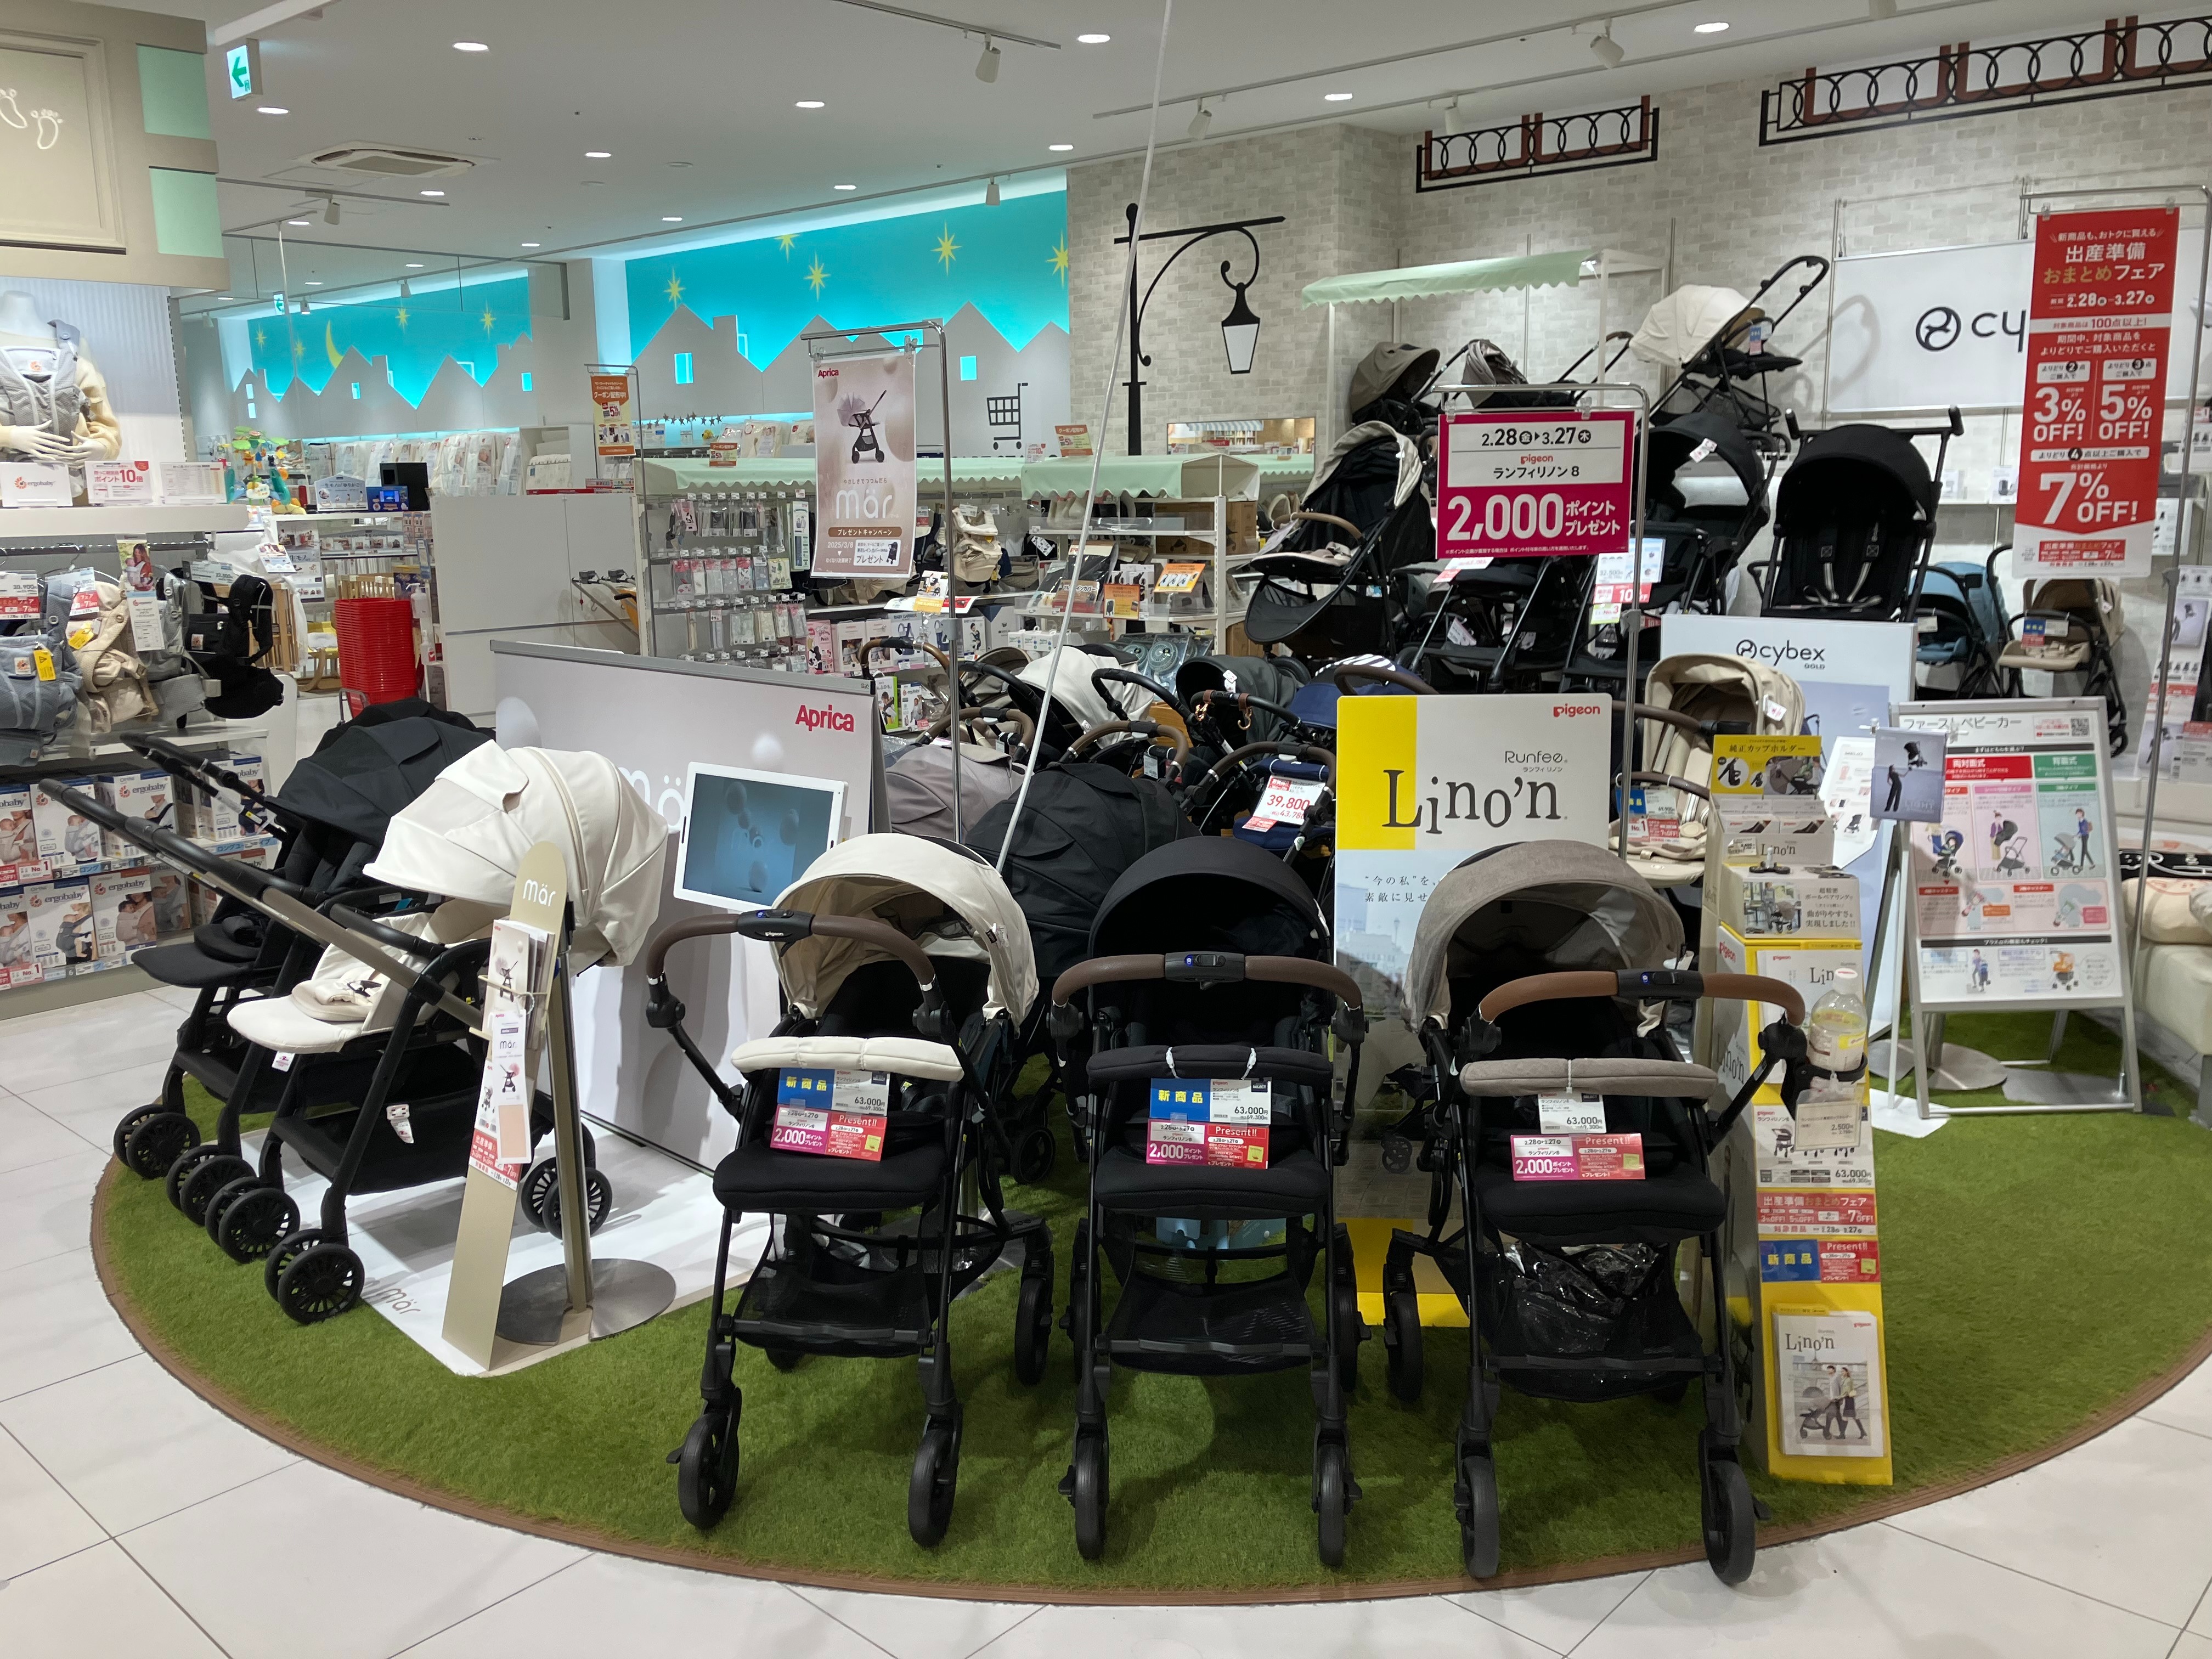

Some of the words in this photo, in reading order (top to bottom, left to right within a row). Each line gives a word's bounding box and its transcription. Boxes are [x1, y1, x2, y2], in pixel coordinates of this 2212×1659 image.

[2066, 242, 2146, 263] 出産準備
[2044, 263, 2165, 284] おまとめフェア
[818, 369, 839, 378] Aprica
[2034, 422, 2083, 442] OFF!
[2099, 421, 2149, 440] OFF!
[1521, 454, 1554, 465] pigeon
[1493, 466, 1568, 479] ランフィリノン
[1571, 466, 1580, 477] 8
[27, 480, 54, 488] ergobaby
[1566, 500, 1616, 517] ポイント
[2077, 500, 2138, 522] OFF!
[1447, 493, 1564, 541] 2,000
[1565, 519, 1621, 537] プレゼント
[856, 555, 884, 564] プレゼント
[1759, 640, 1825, 667] cybex
[795, 704, 855, 732] Aprica
[1553, 703, 1601, 717] pigeon
[1729, 744, 1806, 753] 純正カップホルダー
[132, 782, 167, 794] ergobaby
[1267, 794, 1311, 811] 39,800
[1761, 843, 1796, 856] Lno'n
[109, 879, 146, 891] ergobaby
[523, 878, 556, 907] mär
[45, 891, 84, 903] ergobaby
[1719, 940, 1736, 962] pigeon
[774, 1128, 806, 1146] 2,000
[1149, 1143, 1184, 1159] 2,000
[1516, 1159, 1553, 1174] 2,000
[1764, 1196, 1867, 1206] 出産準備おまとめフェア
